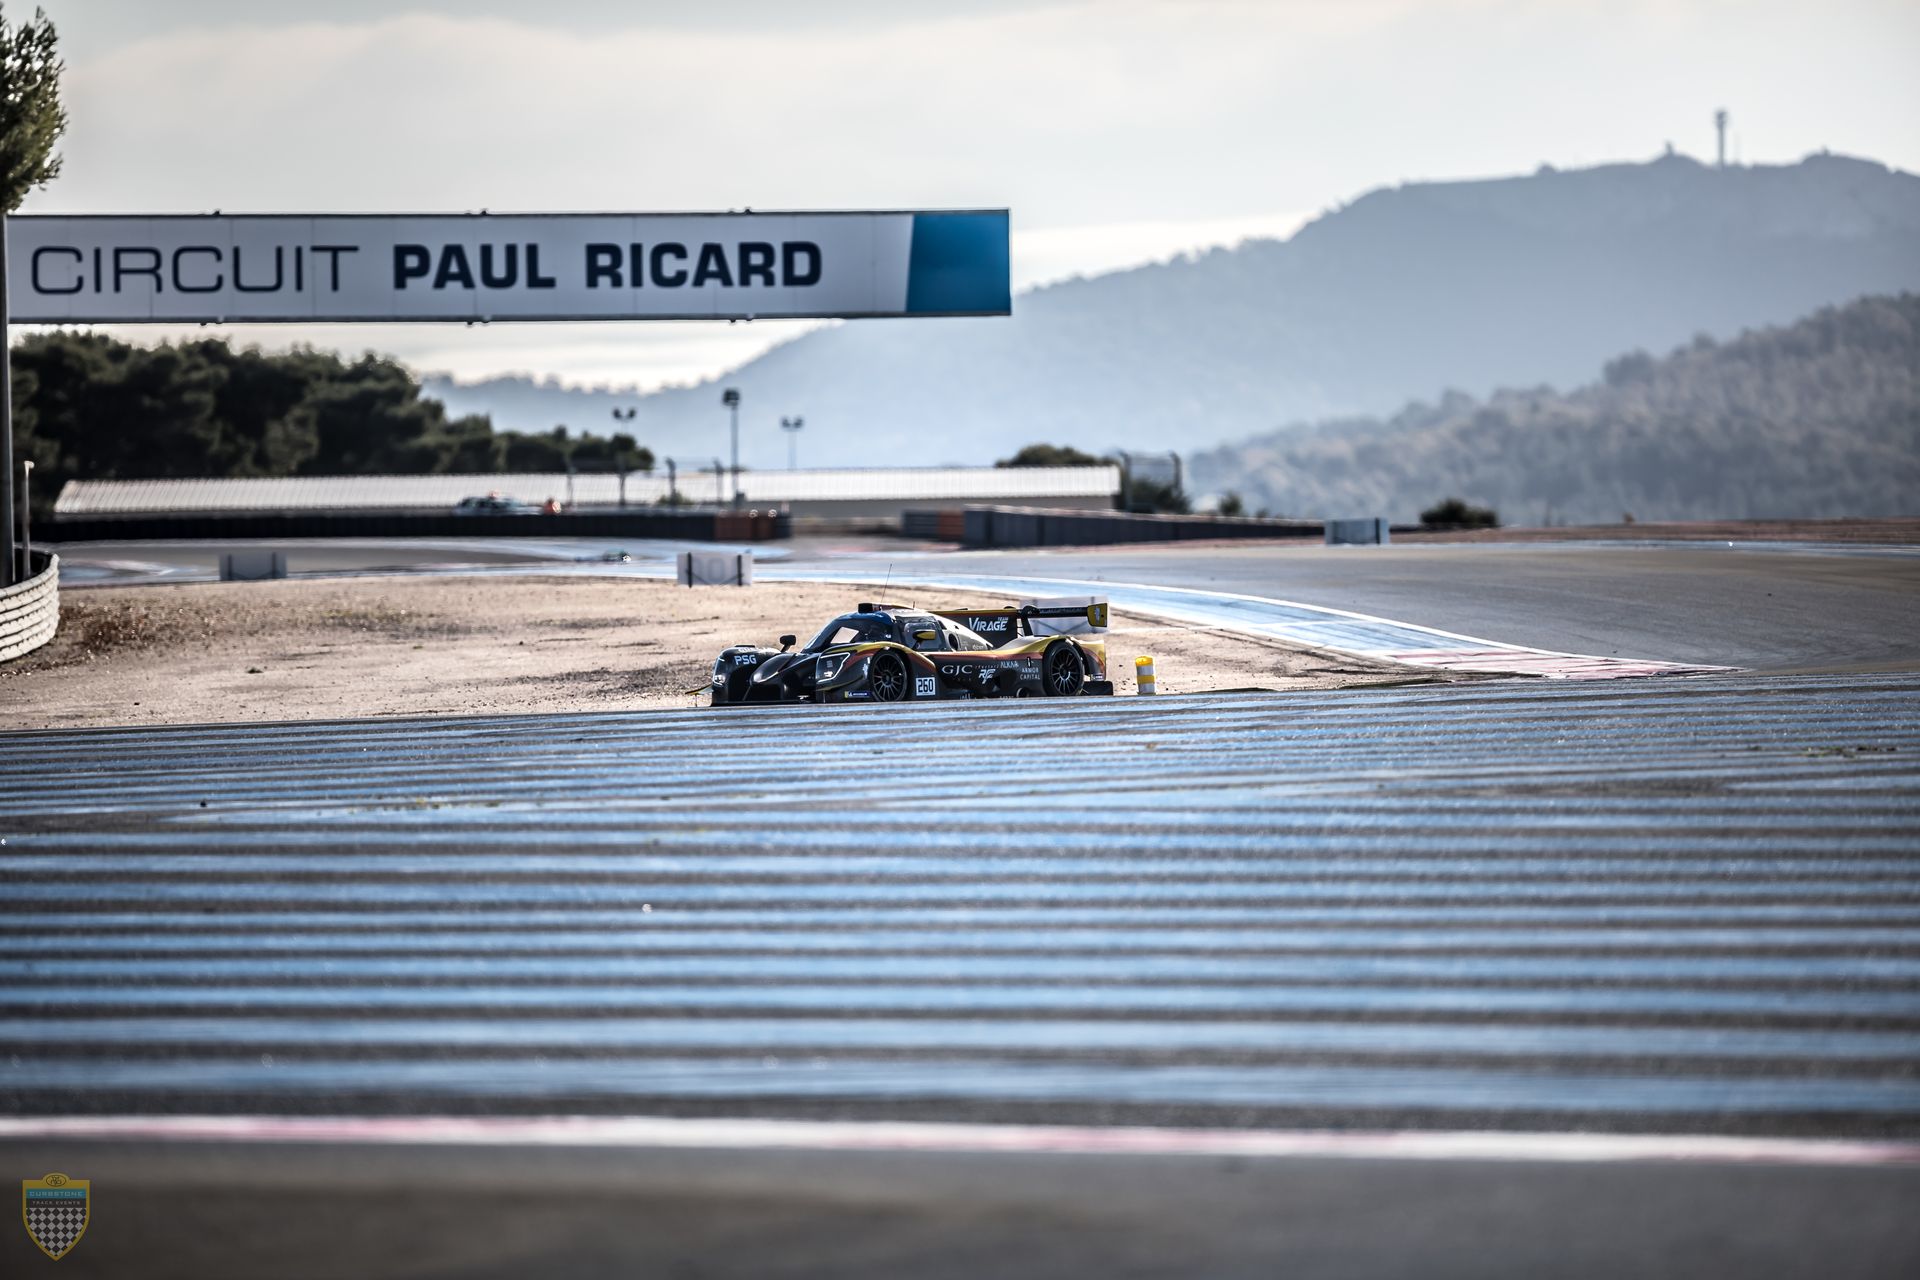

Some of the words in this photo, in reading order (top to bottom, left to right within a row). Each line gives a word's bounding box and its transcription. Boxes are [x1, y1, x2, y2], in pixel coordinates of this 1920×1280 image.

[31, 245, 359, 294] CIRCUIT
[393, 244, 556, 289] PAUL
[586, 242, 822, 288] RICARD
[734, 654, 757, 665] PSG
[942, 665, 972, 675] GJC
[918, 679, 933, 692] 260
